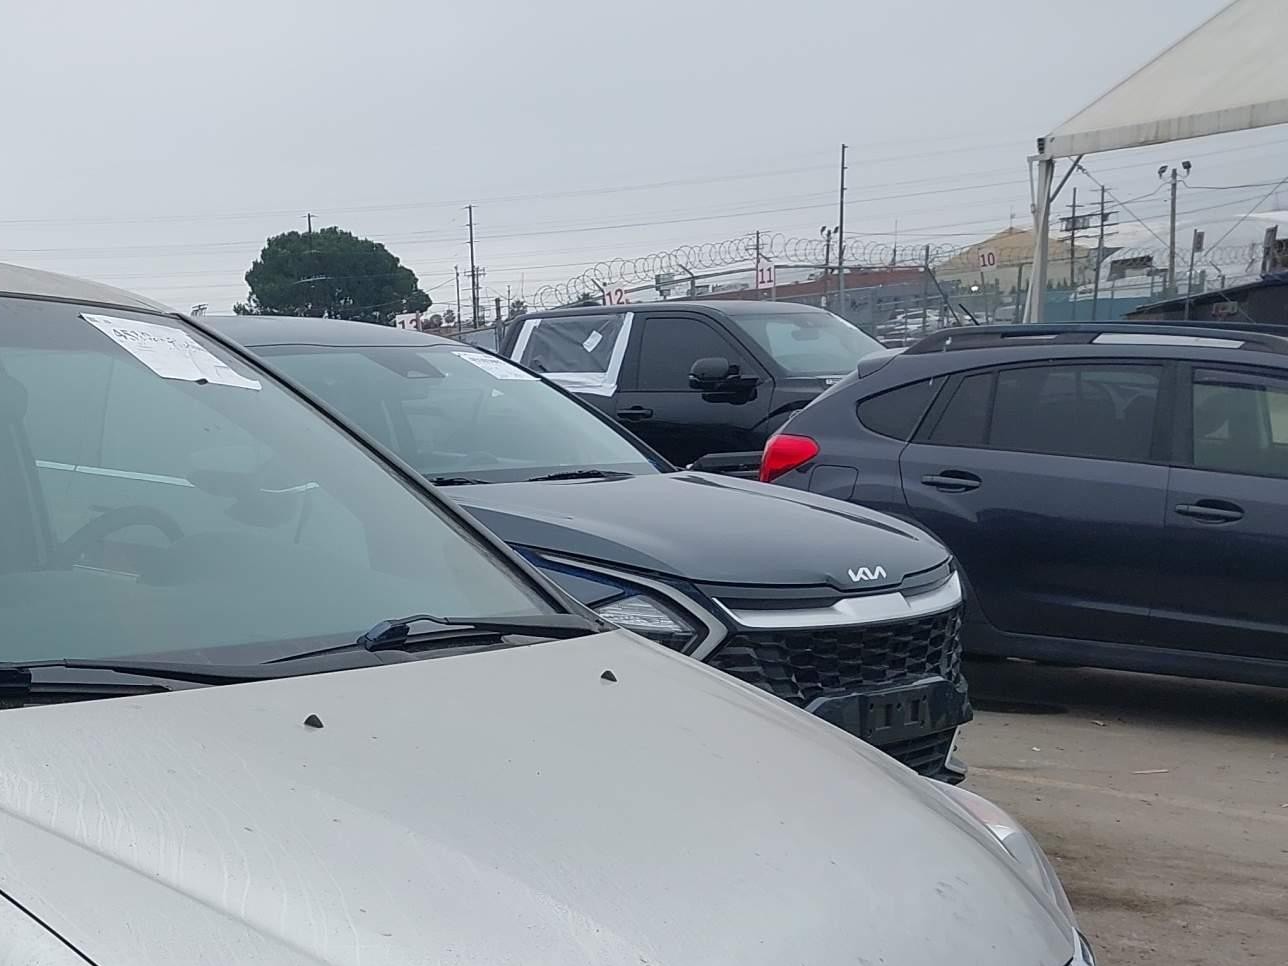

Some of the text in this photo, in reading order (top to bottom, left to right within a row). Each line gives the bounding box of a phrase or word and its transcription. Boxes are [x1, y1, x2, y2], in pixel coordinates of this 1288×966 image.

[980, 252, 996, 267] 10
[759, 267, 775, 285] 11
[606, 288, 625, 305] 12
